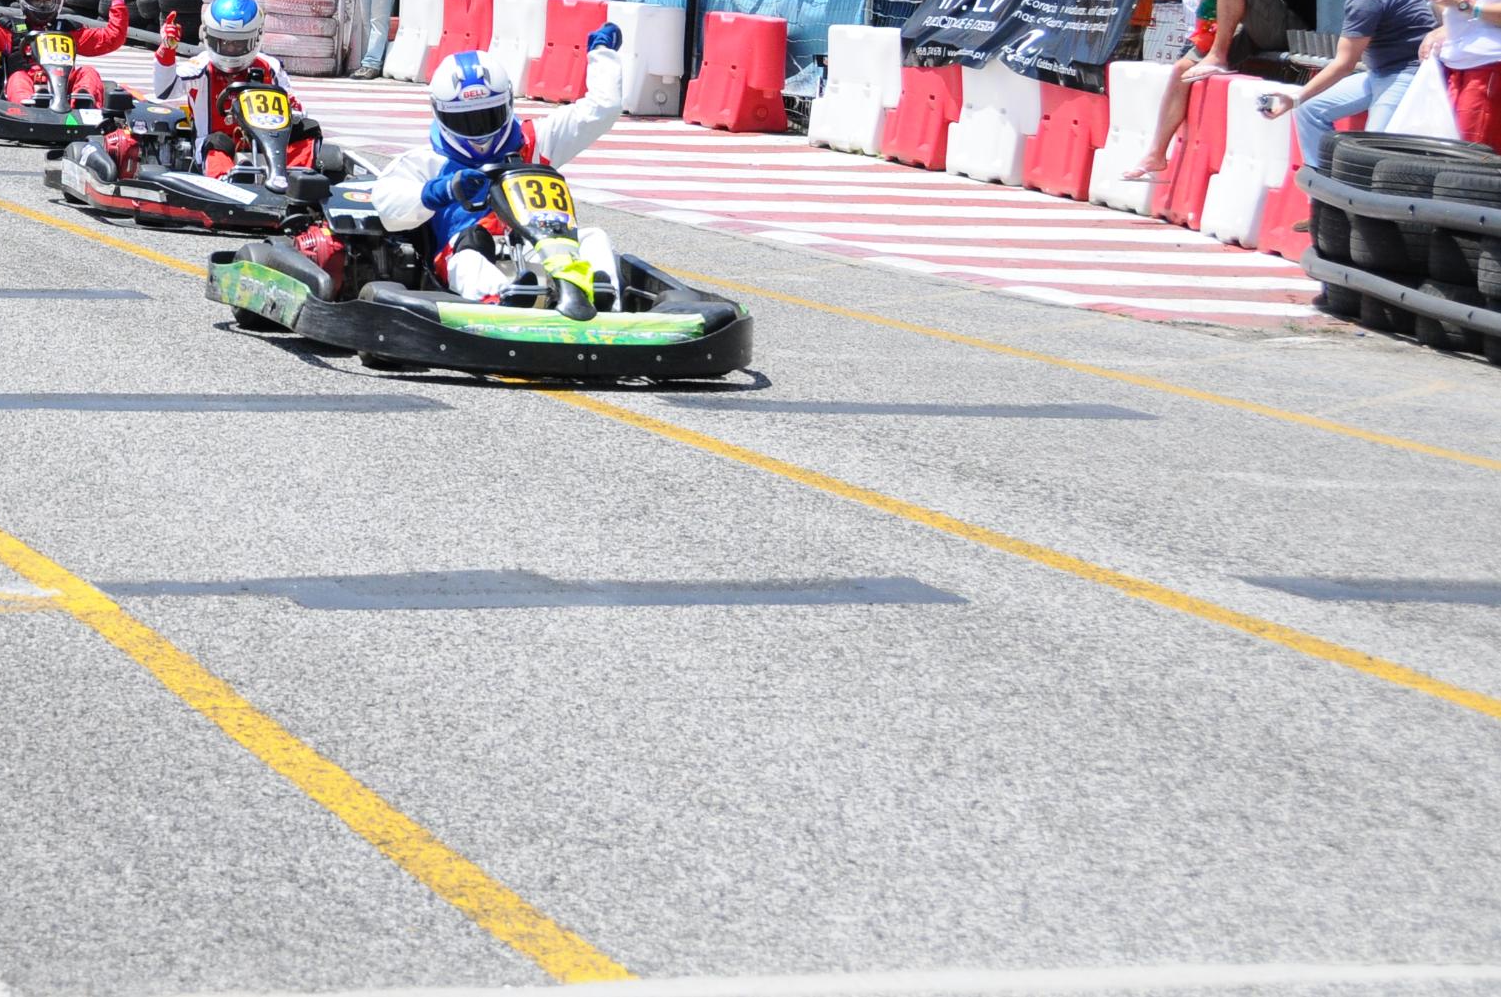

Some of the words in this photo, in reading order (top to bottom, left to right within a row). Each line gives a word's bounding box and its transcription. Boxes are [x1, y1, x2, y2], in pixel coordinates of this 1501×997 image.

[40, 36, 70, 54] 115
[462, 88, 487, 99] BELL
[243, 94, 284, 116] 134
[509, 179, 568, 212] 133
